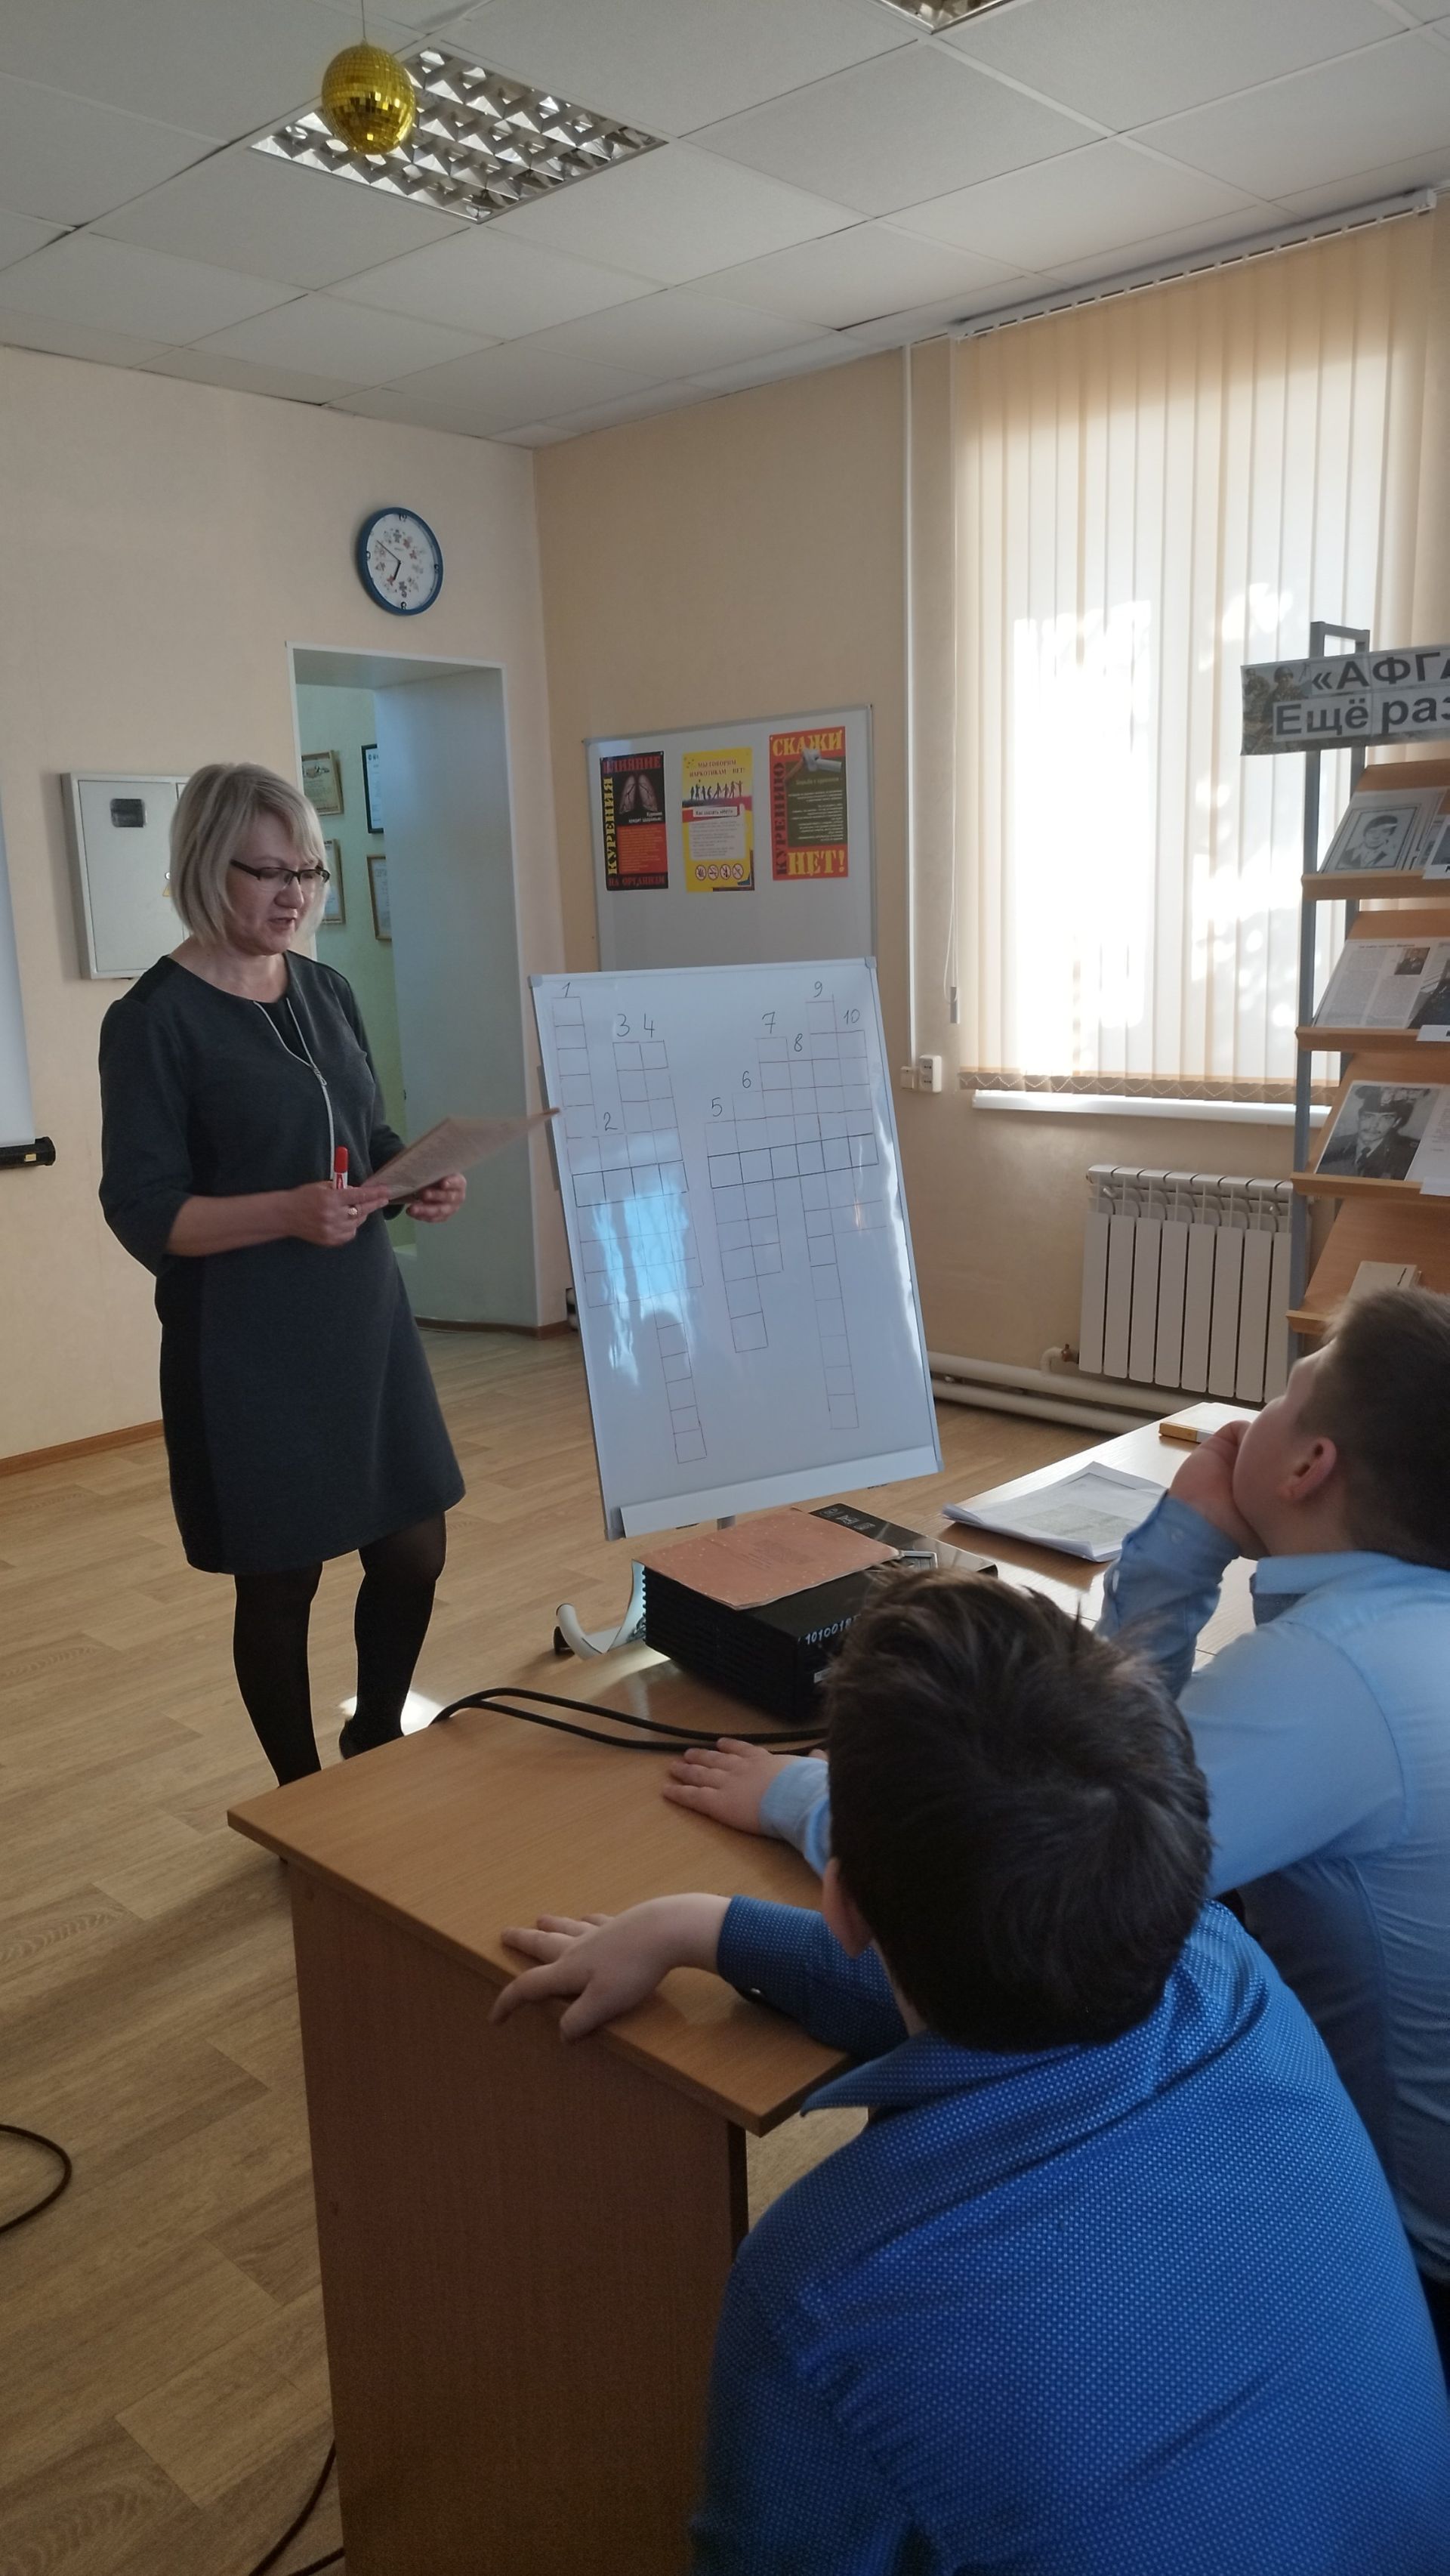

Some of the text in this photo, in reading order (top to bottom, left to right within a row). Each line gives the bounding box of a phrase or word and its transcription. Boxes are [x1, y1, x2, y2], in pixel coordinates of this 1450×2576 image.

[1276, 697, 1369, 736] Ещё
[773, 732, 842, 756] СКАЖИ
[603, 755, 661, 774] ВЛИЯНИЕ
[690, 768, 727, 777] НАРКОТИКАМ
[603, 777, 618, 876] КУРЕНИЯ
[773, 761, 787, 876] КУРЕНИЮ
[787, 849, 845, 876] НЕТ!
[609, 876, 619, 887] НА
[561, 981, 571, 997] 1
[813, 981, 823, 998] 9
[616, 1013, 631, 1037] 3
[643, 1013, 656, 1036] 4
[762, 1012, 777, 1034] 7
[844, 1008, 860, 1024] 10
[793, 1033, 803, 1052] 8
[742, 1070, 751, 1089] 6
[711, 1098, 723, 1117] 5
[603, 1111, 618, 1132] 2
